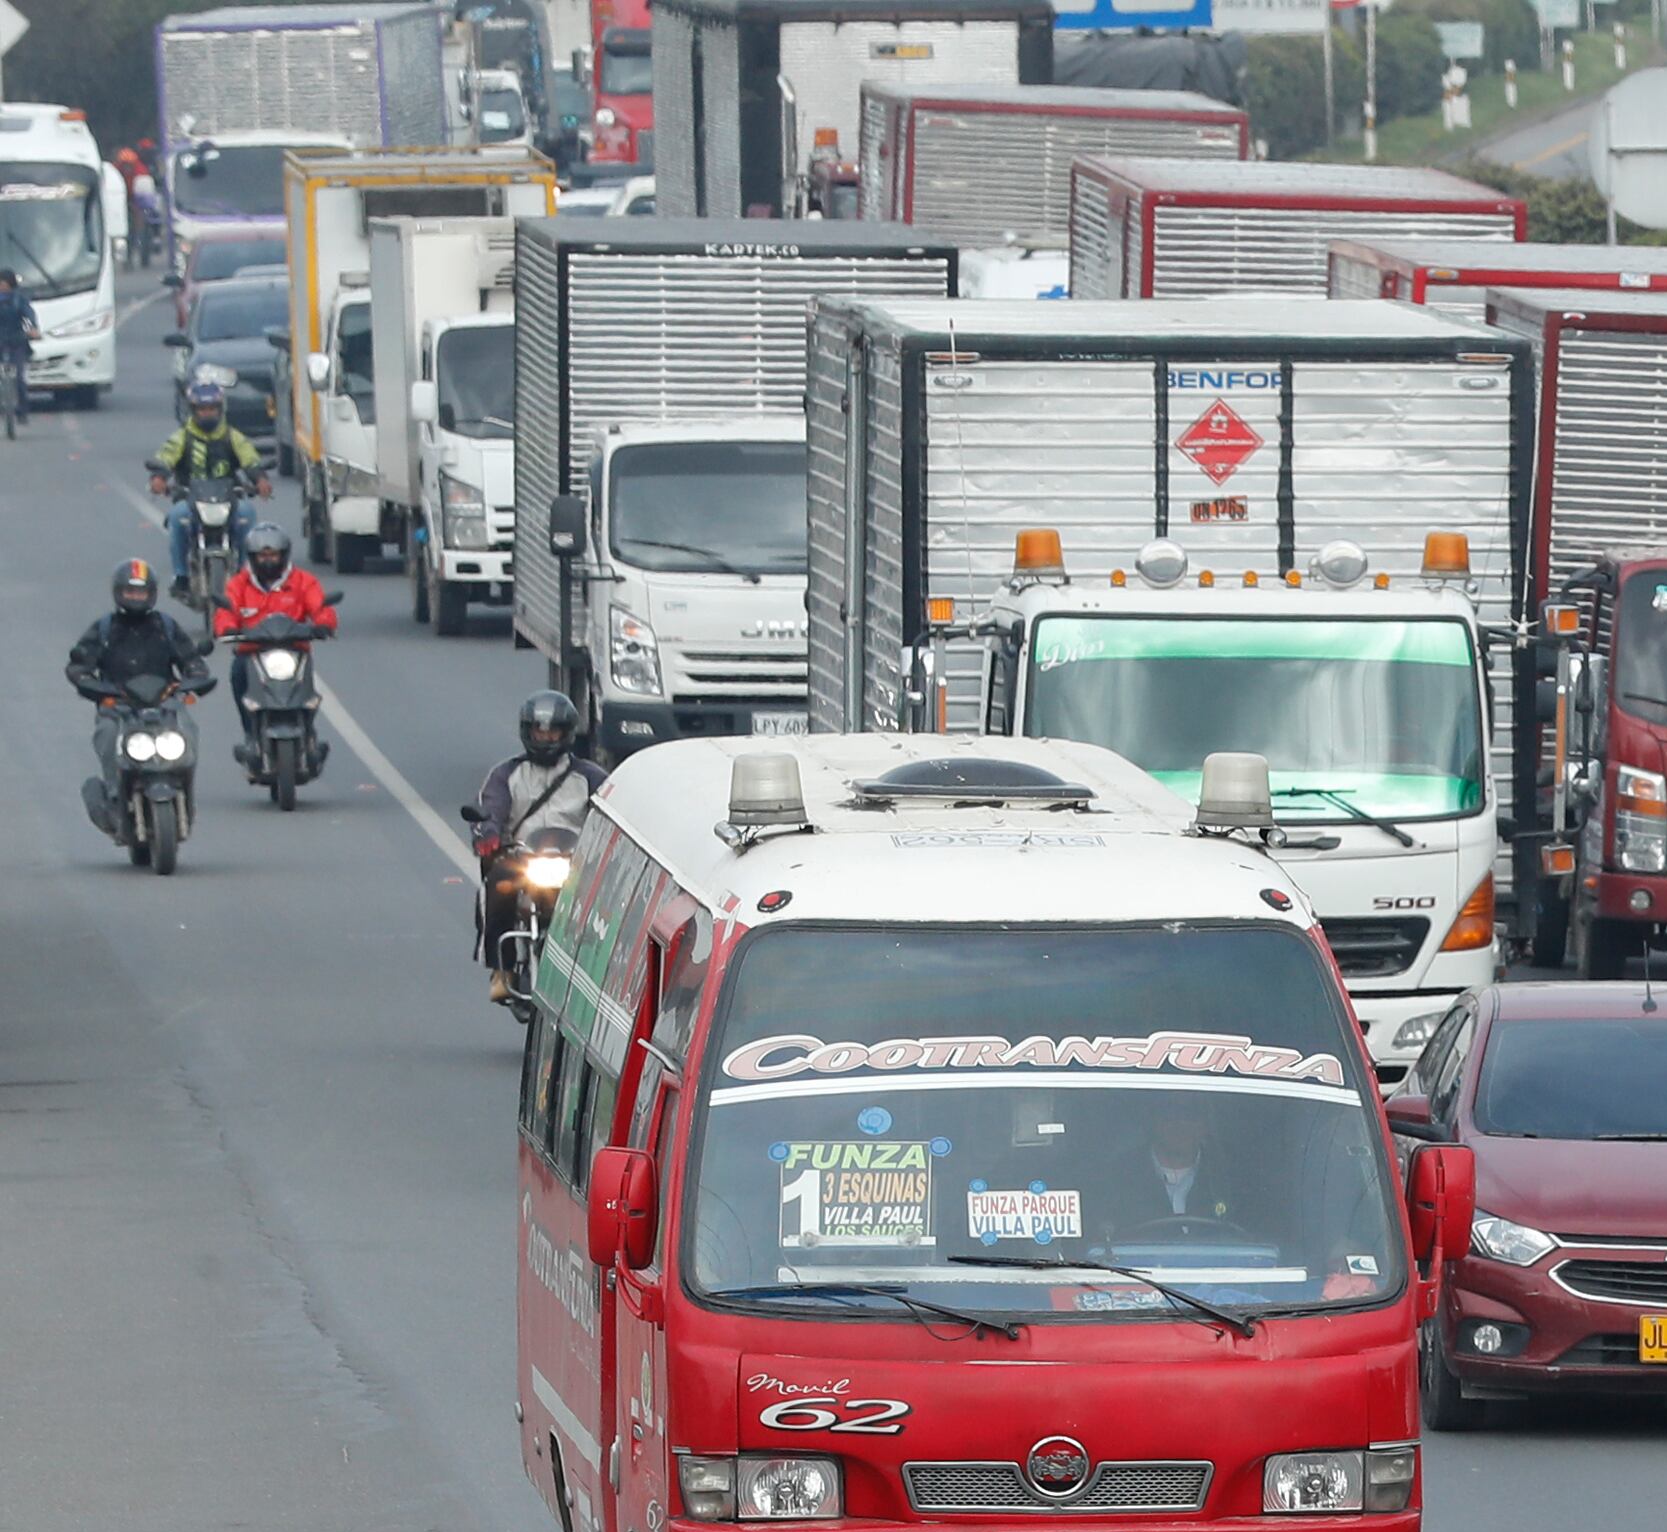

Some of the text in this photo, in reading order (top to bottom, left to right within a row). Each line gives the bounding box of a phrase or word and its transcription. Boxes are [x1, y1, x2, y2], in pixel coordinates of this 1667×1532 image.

[1373, 895, 1436, 911] 500
[785, 1144, 927, 1169] FUNZA
[823, 1172, 928, 1205] 3 ESQUINAS
[782, 1169, 821, 1236] 1
[972, 1196, 1076, 1215] FUNZA PARQUE
[824, 1206, 924, 1225] VILLA PAUL
[972, 1215, 1077, 1236] VILLA PAUL
[759, 1397, 911, 1433] 62
